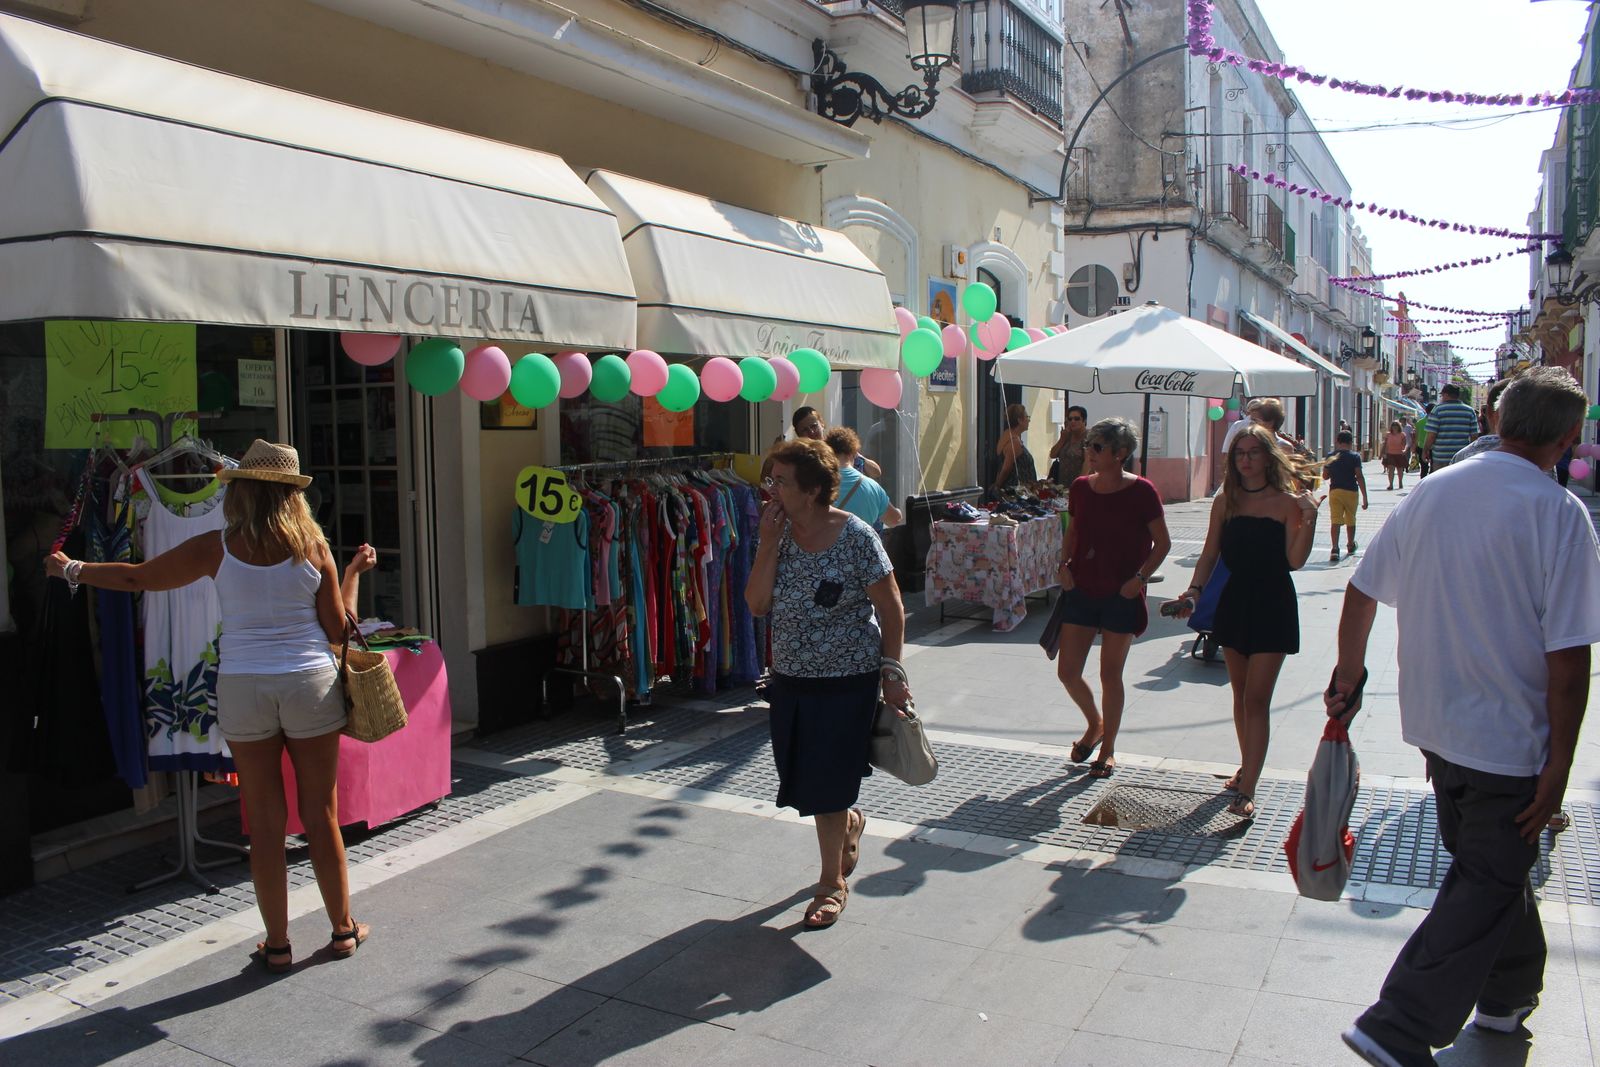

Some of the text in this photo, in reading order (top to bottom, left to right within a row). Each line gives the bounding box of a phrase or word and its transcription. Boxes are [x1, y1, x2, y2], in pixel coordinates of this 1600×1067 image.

[288, 269, 543, 335] LENCERIA
[755, 323, 850, 361] Doña Teresa
[1135, 369, 1200, 392] Coca-Cola
